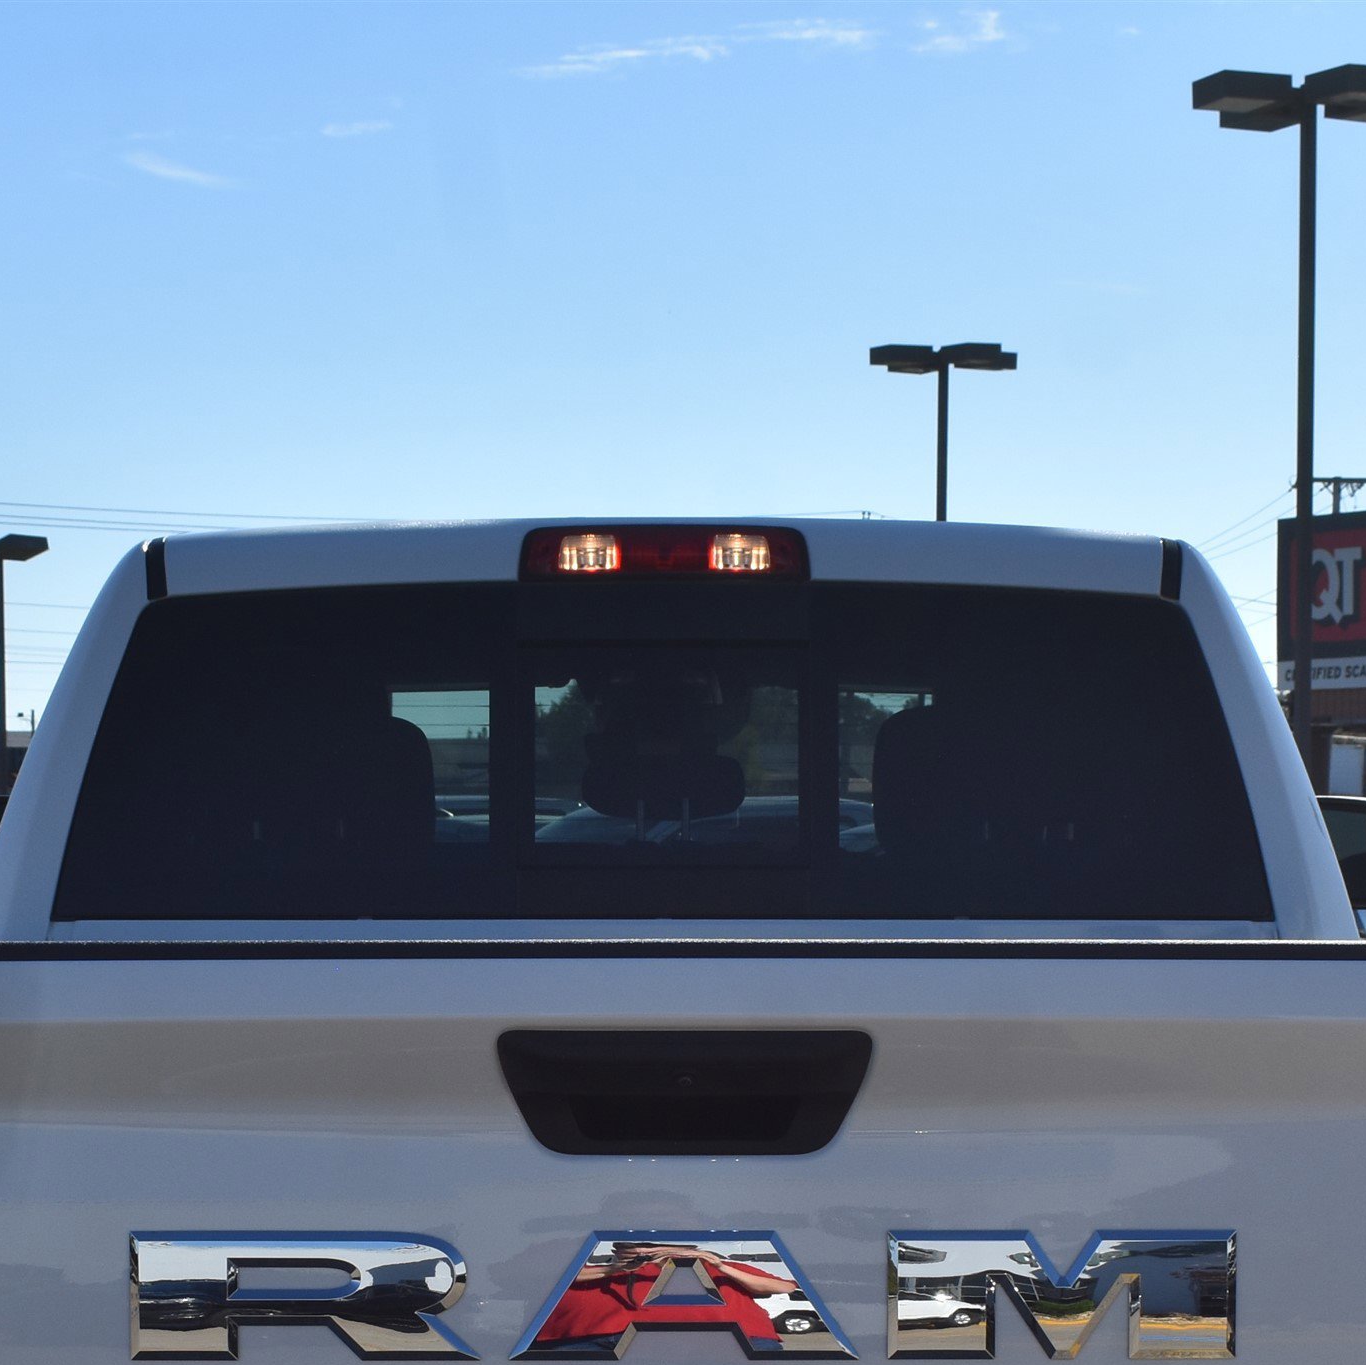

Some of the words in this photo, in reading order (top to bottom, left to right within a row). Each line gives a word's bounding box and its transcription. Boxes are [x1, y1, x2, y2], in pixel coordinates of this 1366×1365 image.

[1310, 546, 1362, 624] QT
[1285, 666, 1341, 681] CIFIED
[128, 1229, 1237, 1361] RAM
